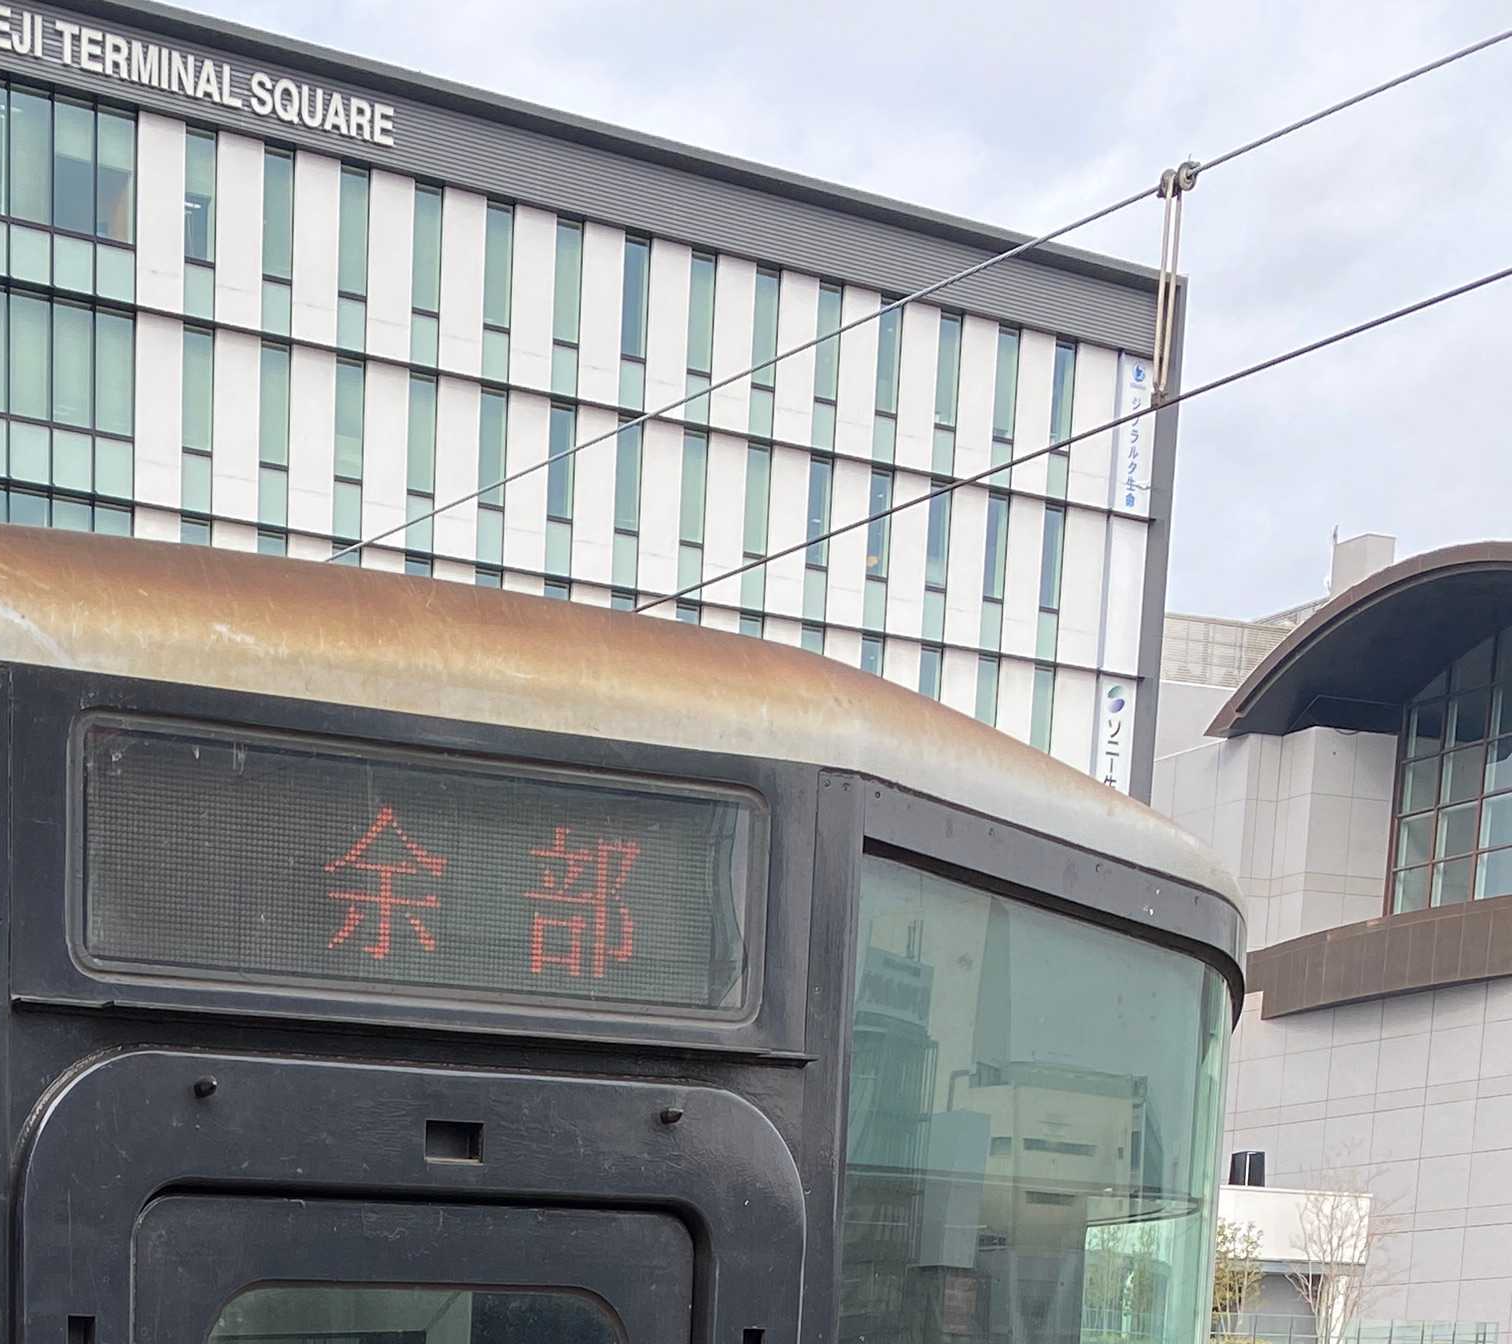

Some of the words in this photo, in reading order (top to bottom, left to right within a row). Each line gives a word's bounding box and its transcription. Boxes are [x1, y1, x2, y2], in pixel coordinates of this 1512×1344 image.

[55, 19, 242, 108] TERMINAL
[249, 71, 396, 147] SQUARE
[324, 806, 641, 978] 余部
